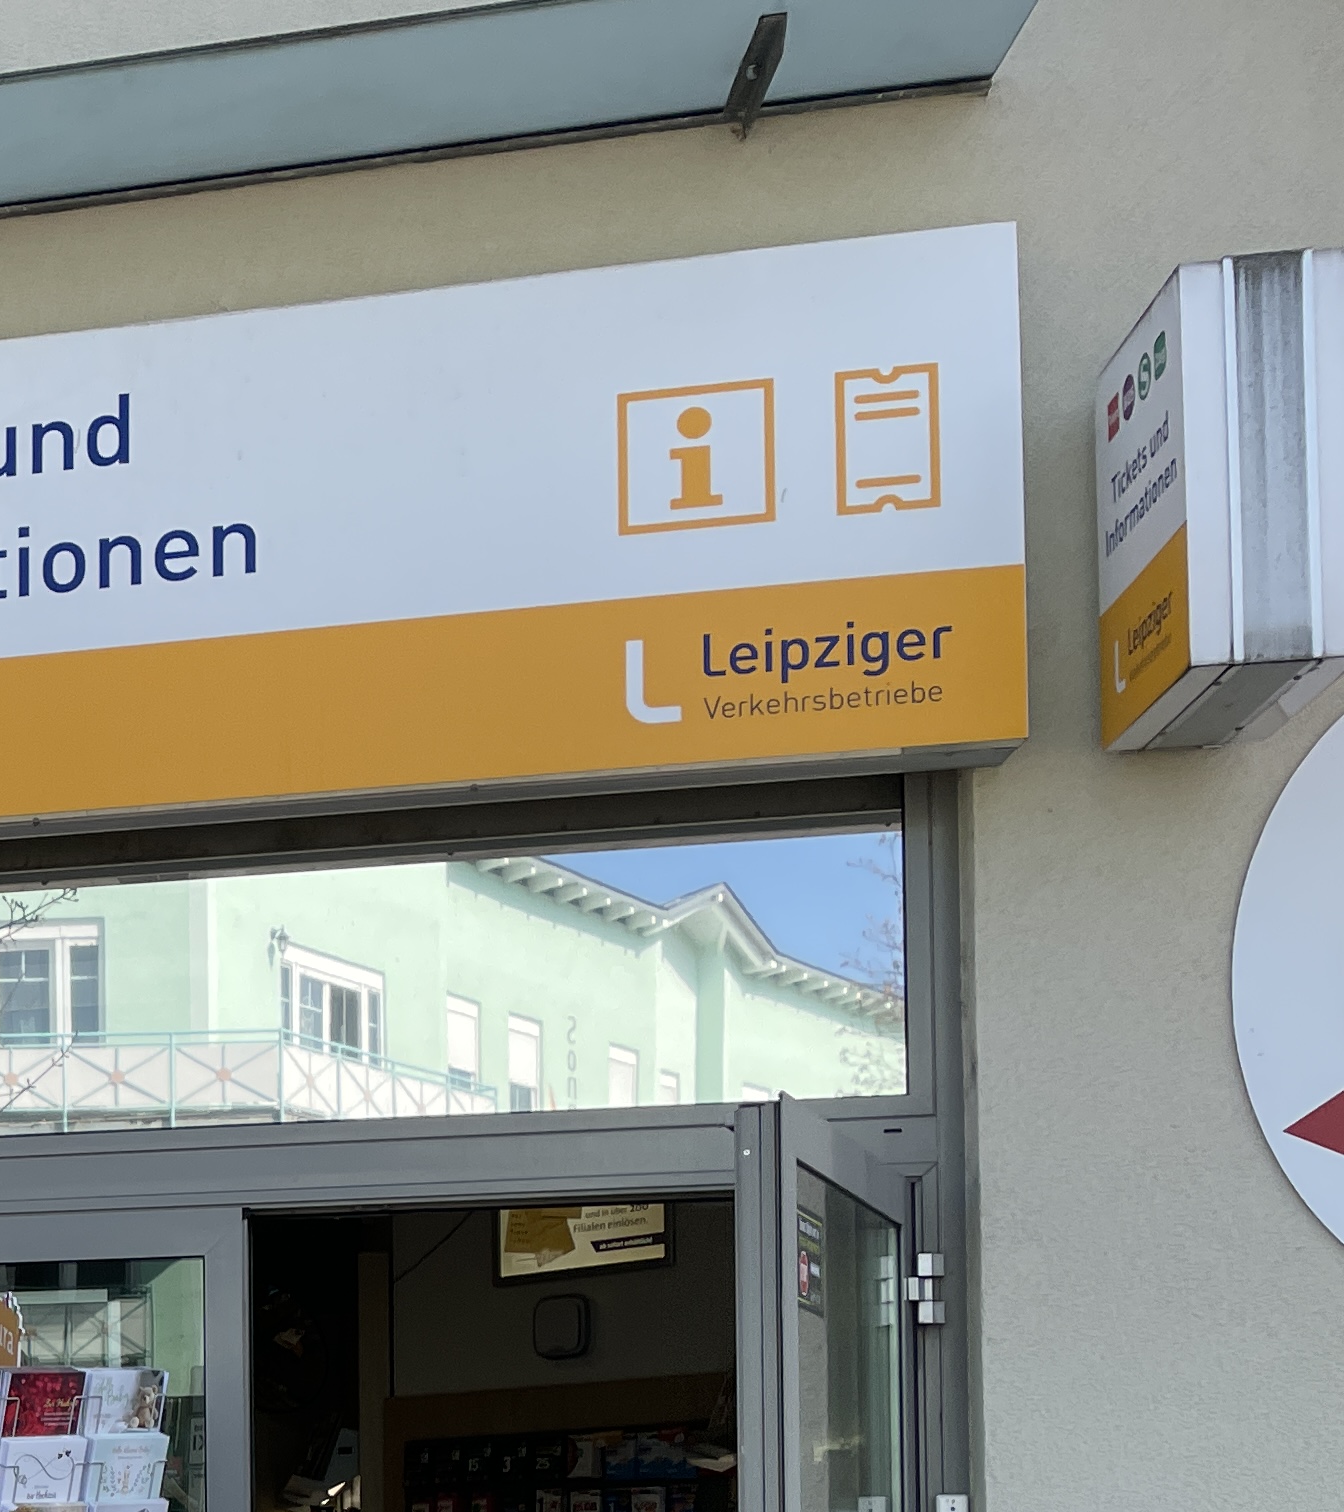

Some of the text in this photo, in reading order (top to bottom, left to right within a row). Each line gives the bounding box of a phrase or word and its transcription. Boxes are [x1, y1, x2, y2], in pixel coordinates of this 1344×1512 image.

[1110, 444, 1148, 502] Tickets
[1149, 410, 1170, 458] und
[1105, 458, 1178, 558] Informationen
[702, 621, 952, 684] Leipziger
[1127, 591, 1173, 656] Leipziger
[703, 681, 943, 720] Verkehrsbetriebe
[573, 1217, 648, 1233] Filialen einlösen.
[585, 1208, 600, 1219] und
